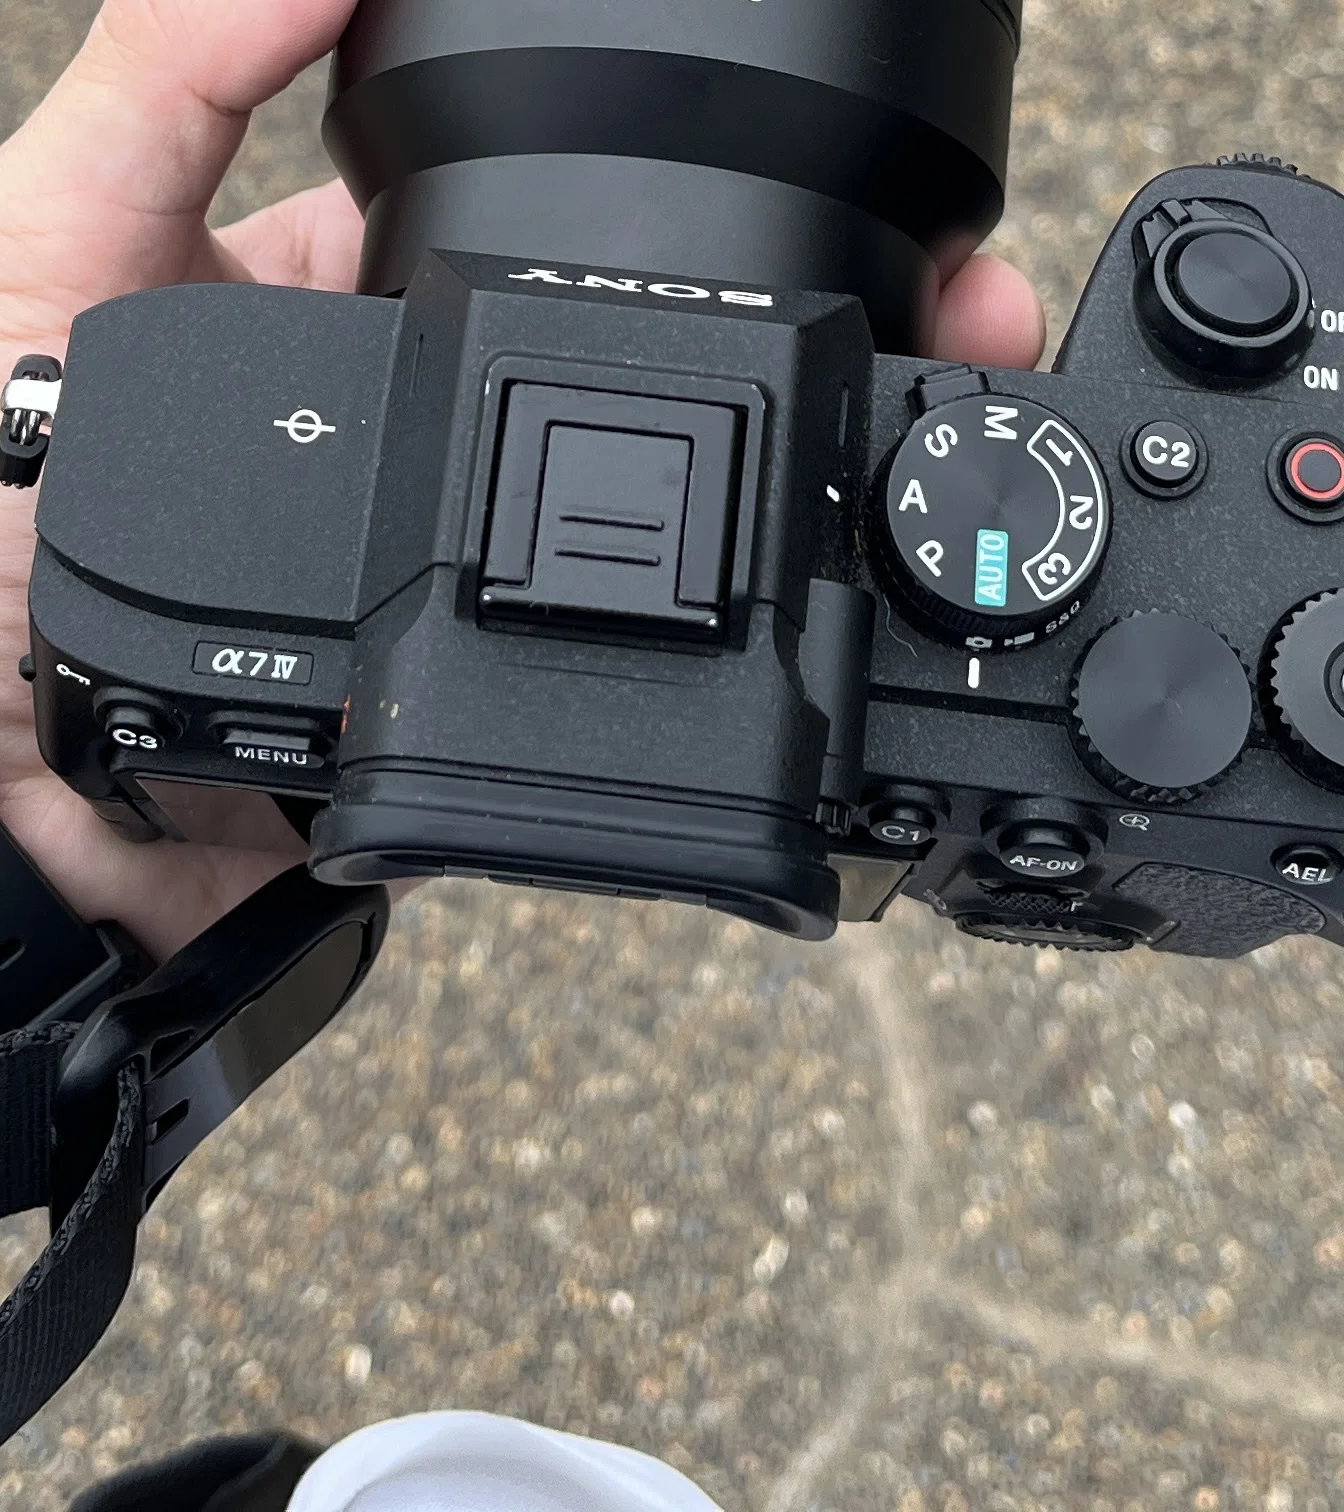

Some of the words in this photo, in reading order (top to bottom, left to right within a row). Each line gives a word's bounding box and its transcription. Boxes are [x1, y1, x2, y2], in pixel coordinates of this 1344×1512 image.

[507, 268, 774, 307] SONY
[1303, 365, 1339, 391] ON
[983, 405, 1018, 440] M
[924, 423, 958, 458] S
[1045, 438, 1073, 466] 1
[1142, 435, 1190, 468] C2
[898, 479, 928, 514] A
[1068, 495, 1094, 530] 2
[915, 540, 944, 577] P
[977, 533, 1005, 601] AUTO
[1037, 552, 1071, 585] 3
[112, 728, 158, 749] C3
[234, 745, 307, 765] MENU
[881, 825, 921, 841] C1
[1009, 854, 1078, 871] AF-ON
[1282, 862, 1334, 883] AEL
